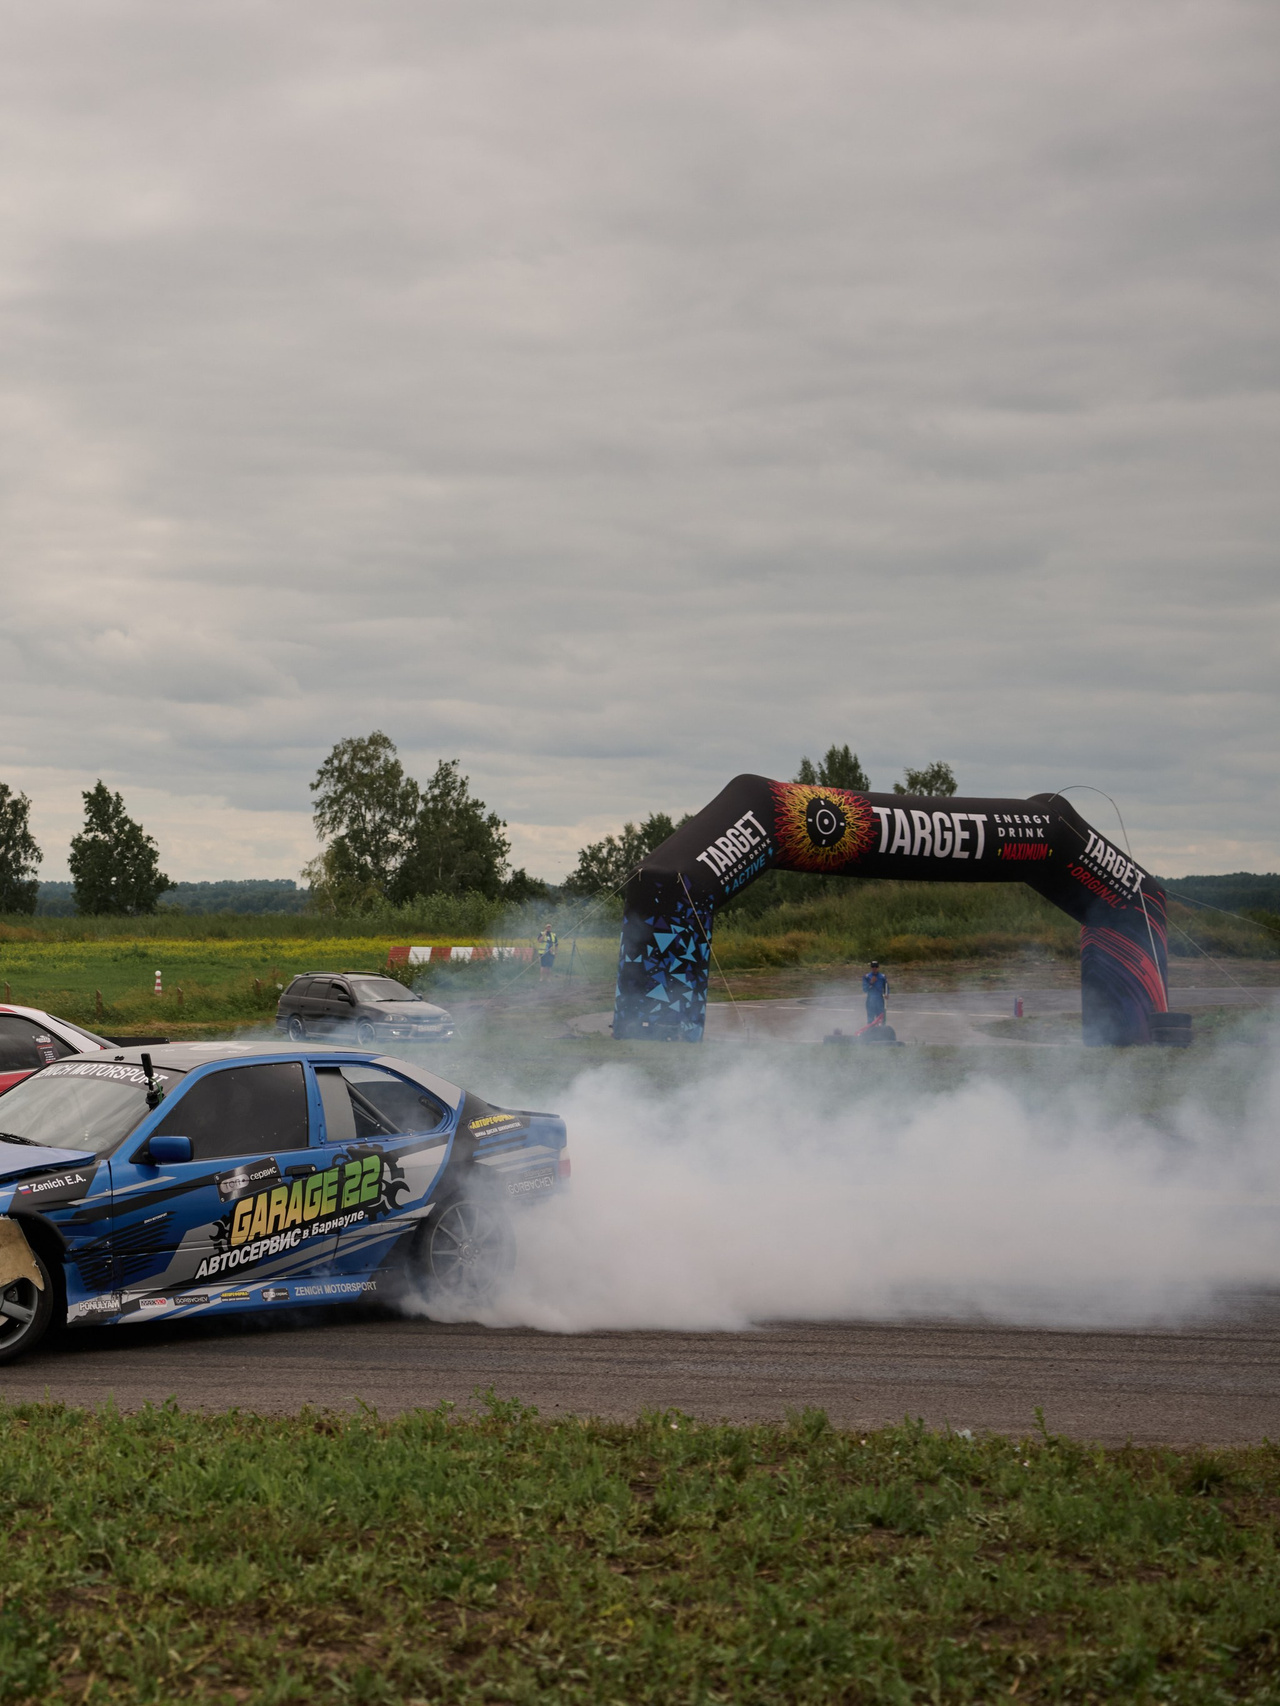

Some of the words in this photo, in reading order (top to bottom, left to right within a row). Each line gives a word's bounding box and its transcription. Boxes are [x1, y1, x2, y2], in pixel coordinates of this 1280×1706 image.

[871, 805, 988, 860] TARGET
[993, 813, 1051, 824] ENERGY
[998, 827, 1045, 838] DRINK
[696, 810, 768, 878] TARGET
[720, 860, 747, 885] ENERGY
[749, 838, 772, 860] DRINK
[1001, 843, 1048, 861] MAXIMUM
[1084, 829, 1146, 893] TARGET
[732, 853, 766, 891] ACTIVE
[1070, 866, 1123, 909] ORIGINAL
[1078, 854, 1108, 879] ENERGY
[1109, 880, 1133, 900] DRINK
[69, 1063, 169, 1086] MOTORSPORT
[29, 1178, 65, 1193] Zenich
[64, 1174, 87, 1185] E.A.
[250, 1166, 277, 1181] сервис
[231, 1167, 339, 1247] GARAGE
[341, 1154, 380, 1209] 22
[194, 1227, 302, 1279] АВТОСЕРВИС
[302, 1229, 309, 1240] в
[312, 1210, 365, 1236] Барнауле
[294, 1284, 323, 1297] ZENICH
[324, 1281, 377, 1294] MOTORSPORT
